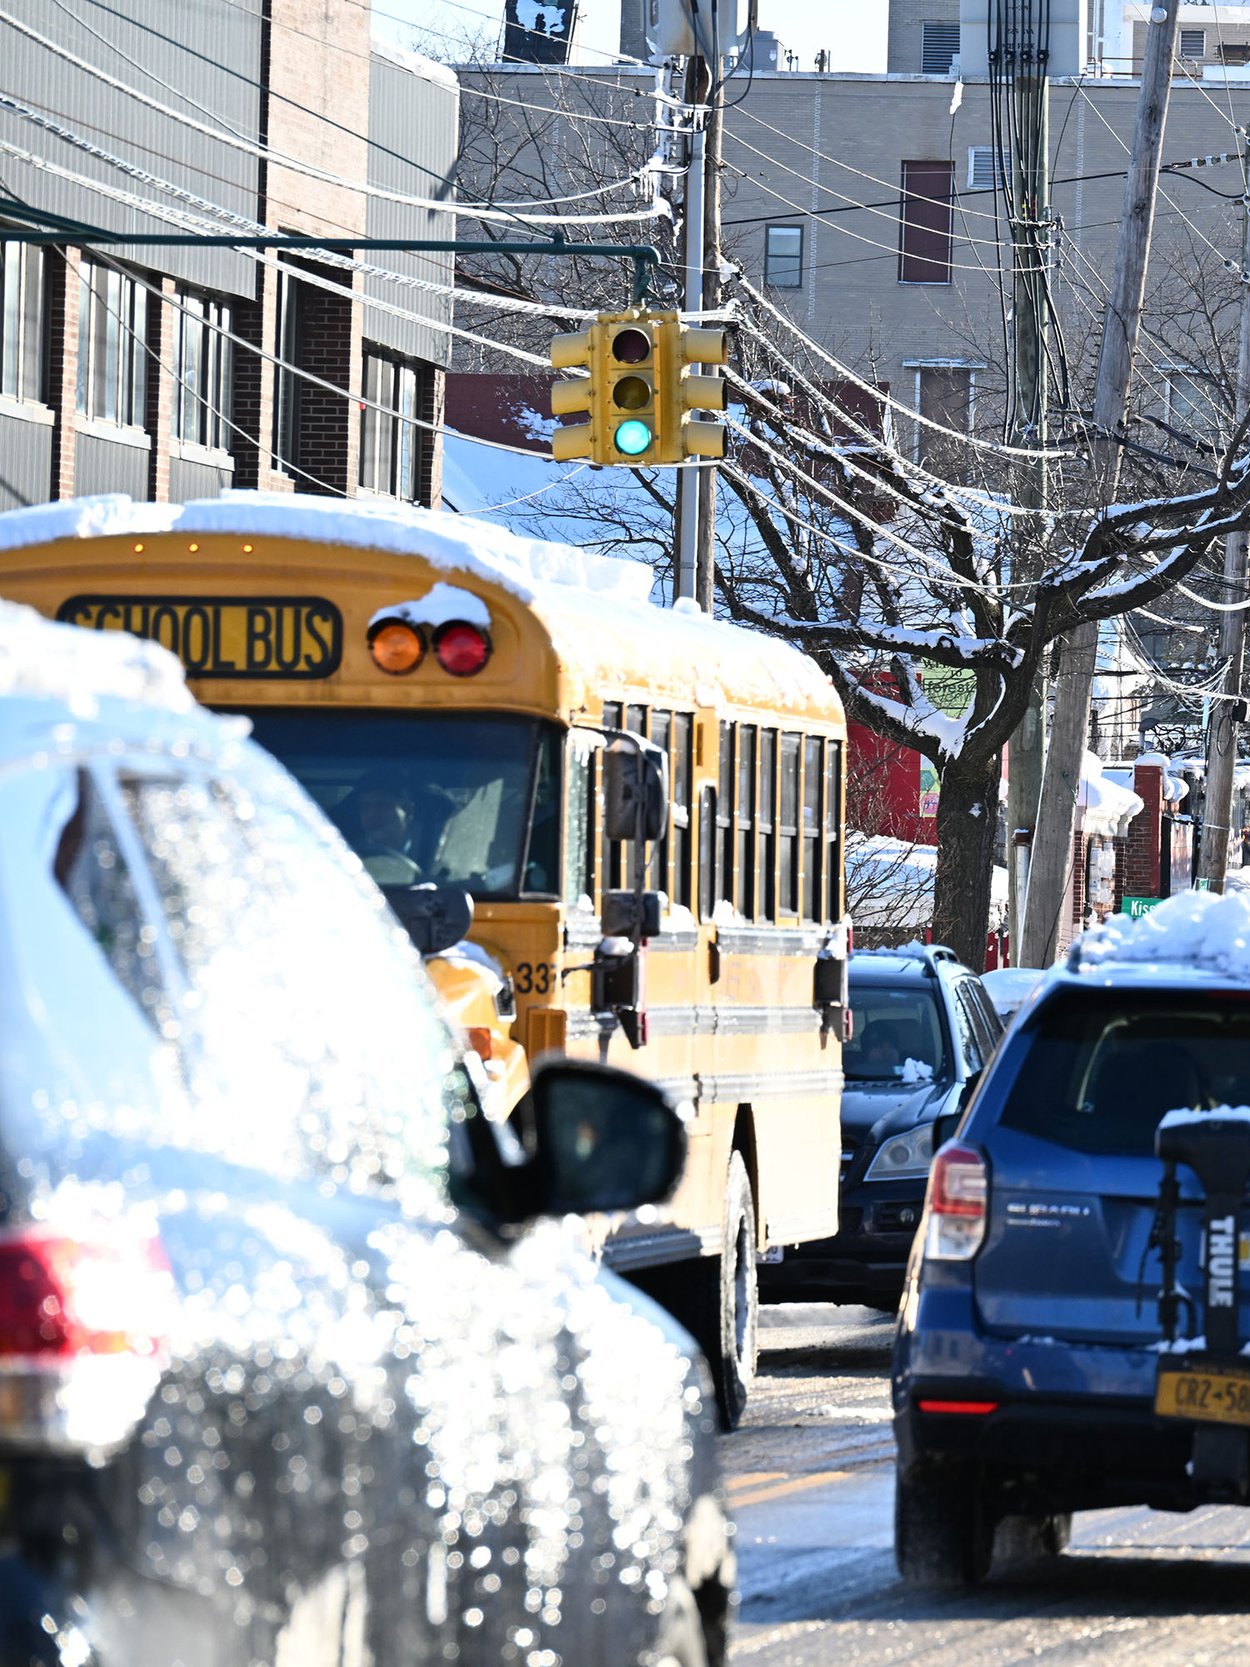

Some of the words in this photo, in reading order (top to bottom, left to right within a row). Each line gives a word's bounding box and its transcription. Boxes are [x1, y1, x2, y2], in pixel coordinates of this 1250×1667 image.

[68, 604, 235, 670] HOOL
[246, 605, 331, 671] BUS
[1208, 1214, 1235, 1308] THULE
